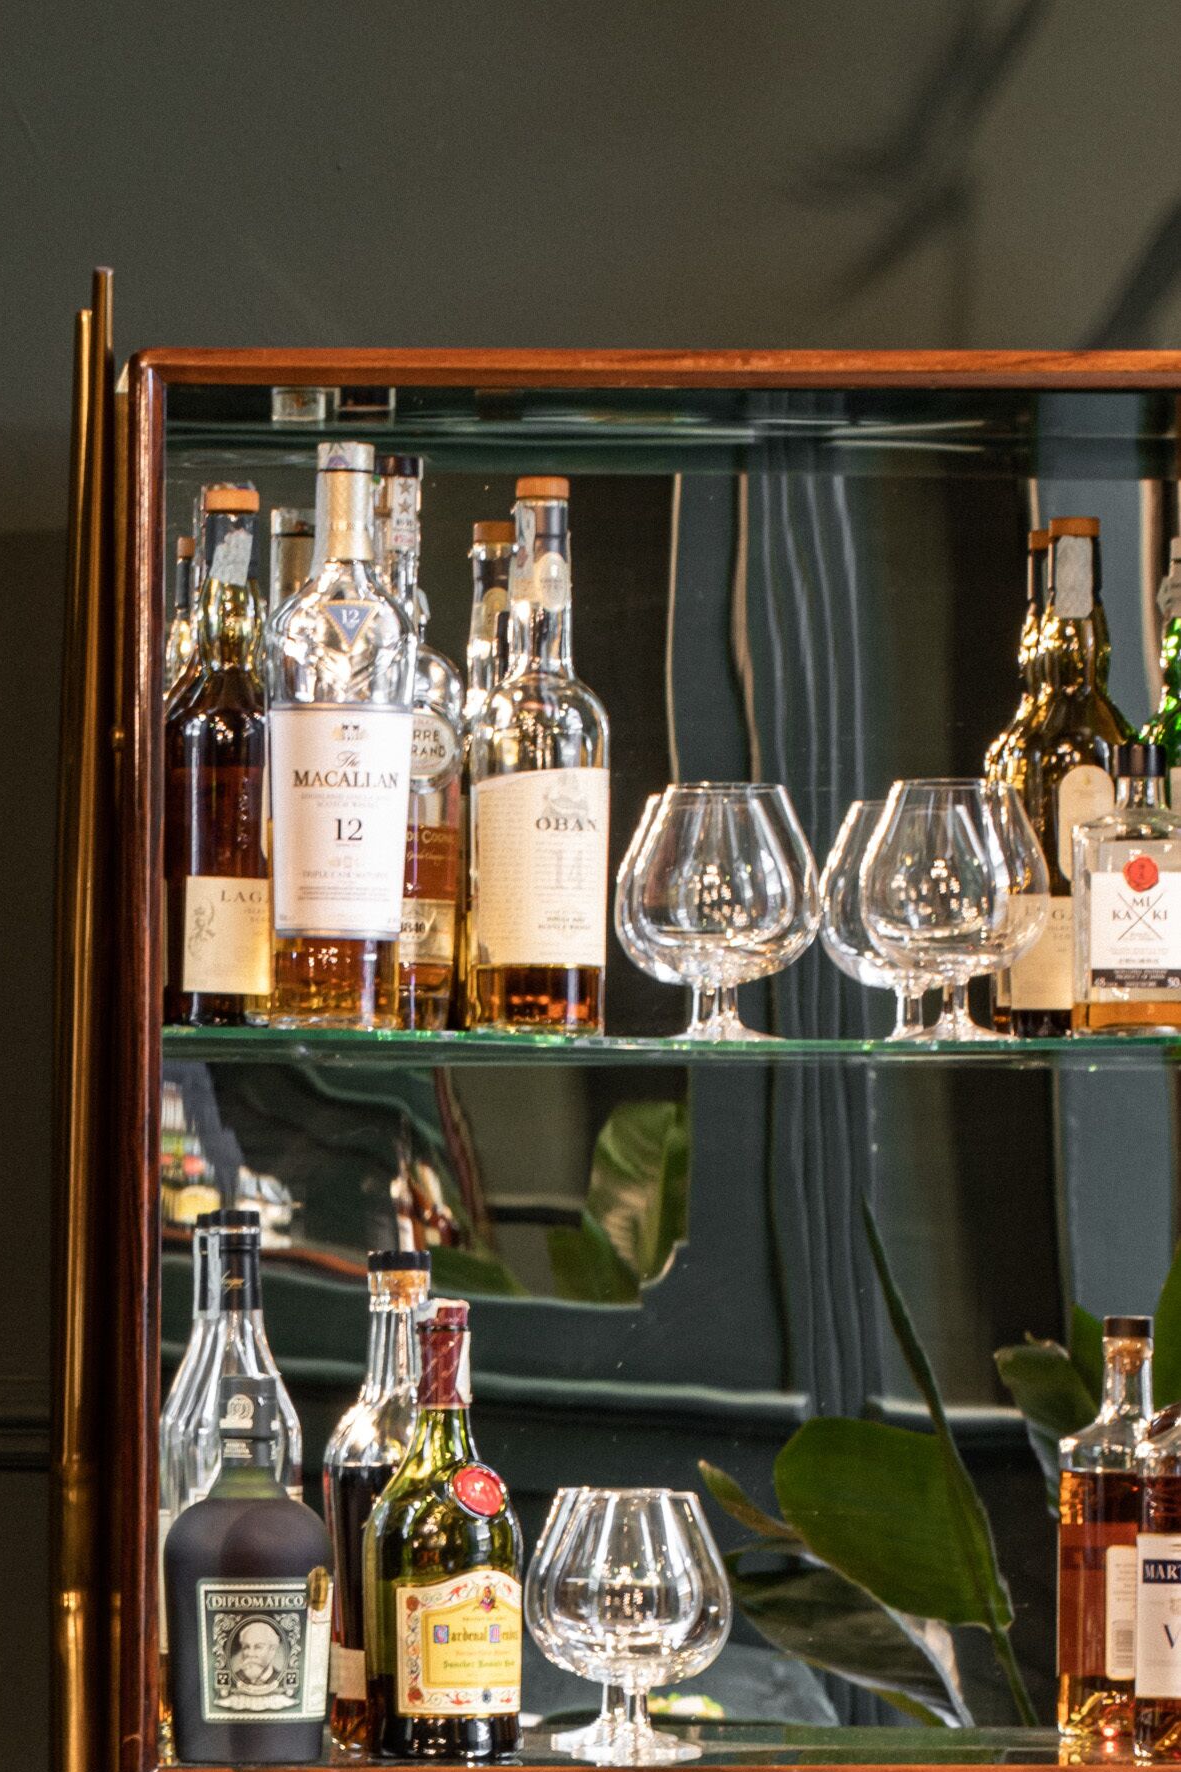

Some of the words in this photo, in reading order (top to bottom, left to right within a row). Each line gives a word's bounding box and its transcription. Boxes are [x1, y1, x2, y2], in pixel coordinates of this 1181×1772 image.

[341, 608, 360, 624] 12
[336, 750, 360, 767] The
[293, 769, 398, 788] MACALLAN
[335, 818, 363, 841] 12
[535, 816, 598, 832] OBAN
[221, 890, 268, 903] LAG
[1133, 896, 1150, 907] MI
[1113, 910, 1132, 921] KA
[1153, 910, 1167, 921] KI
